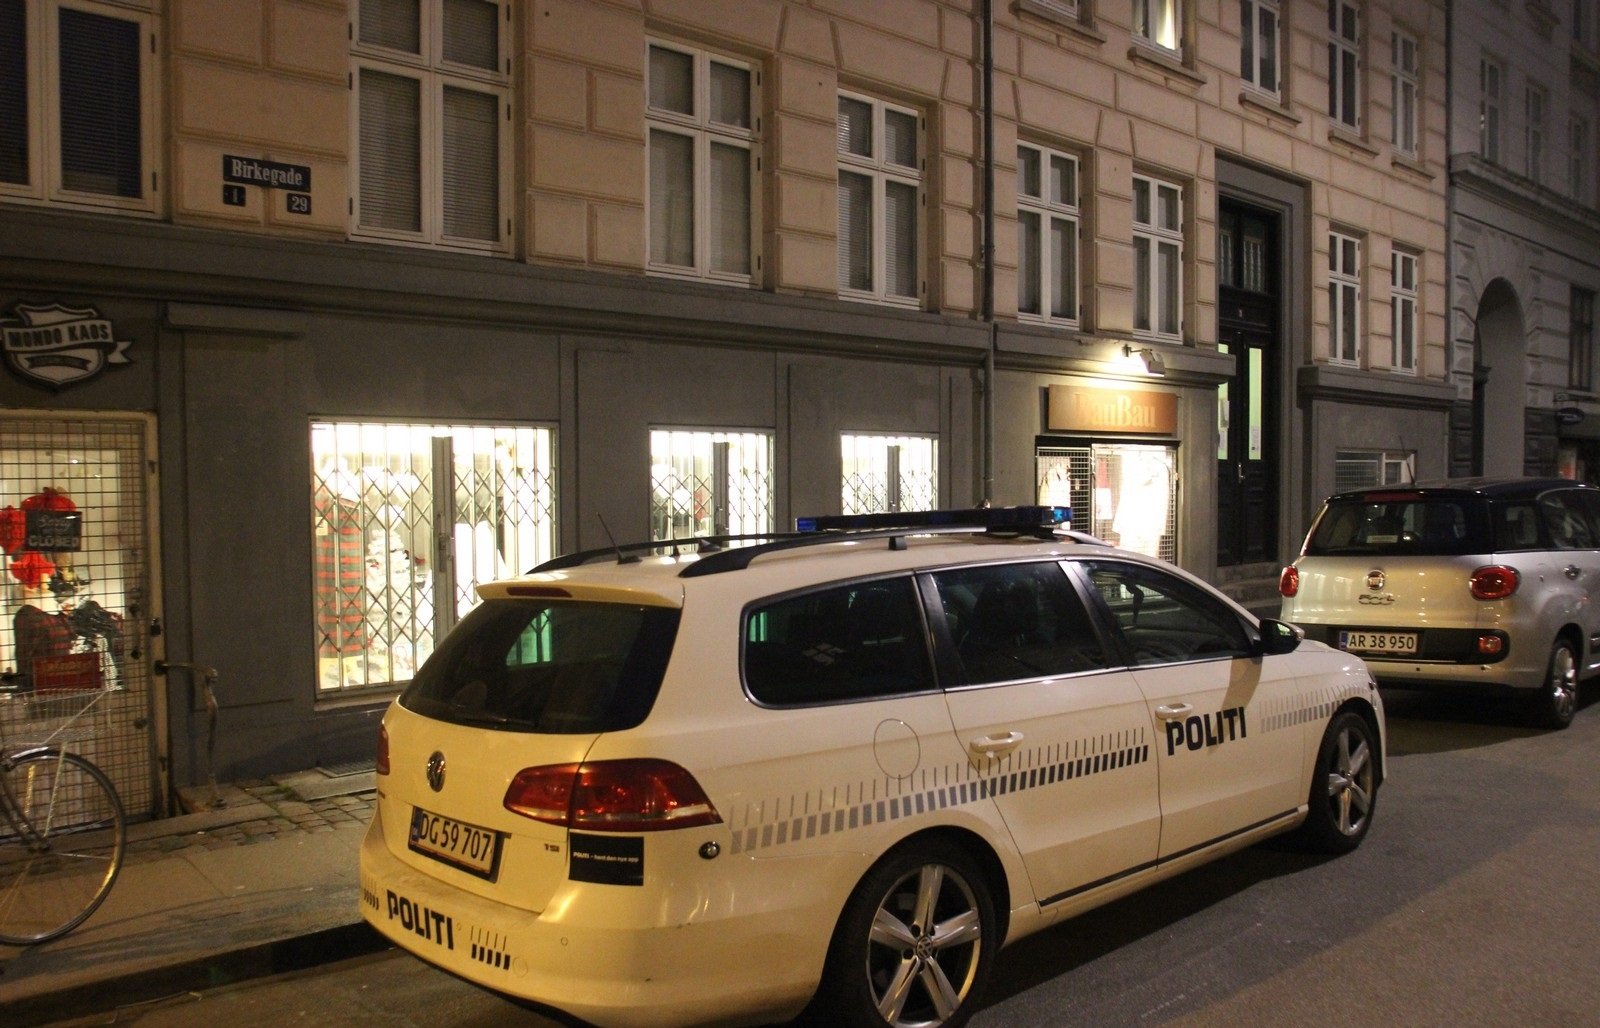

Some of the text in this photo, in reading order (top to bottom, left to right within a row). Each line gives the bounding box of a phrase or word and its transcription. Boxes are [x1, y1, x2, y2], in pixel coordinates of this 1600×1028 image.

[231, 159, 303, 186] Birkegade
[291, 195, 308, 212] 29
[8, 324, 109, 348] MONDO KAOS
[29, 535, 80, 548] CLOSED
[1349, 634, 1366, 647] AR
[1370, 635, 1386, 648] 38
[1390, 636, 1414, 649] 950
[1165, 706, 1247, 756] POLITI
[440, 820, 460, 852] 59
[461, 826, 492, 861] 707
[386, 889, 454, 950] POLITI
